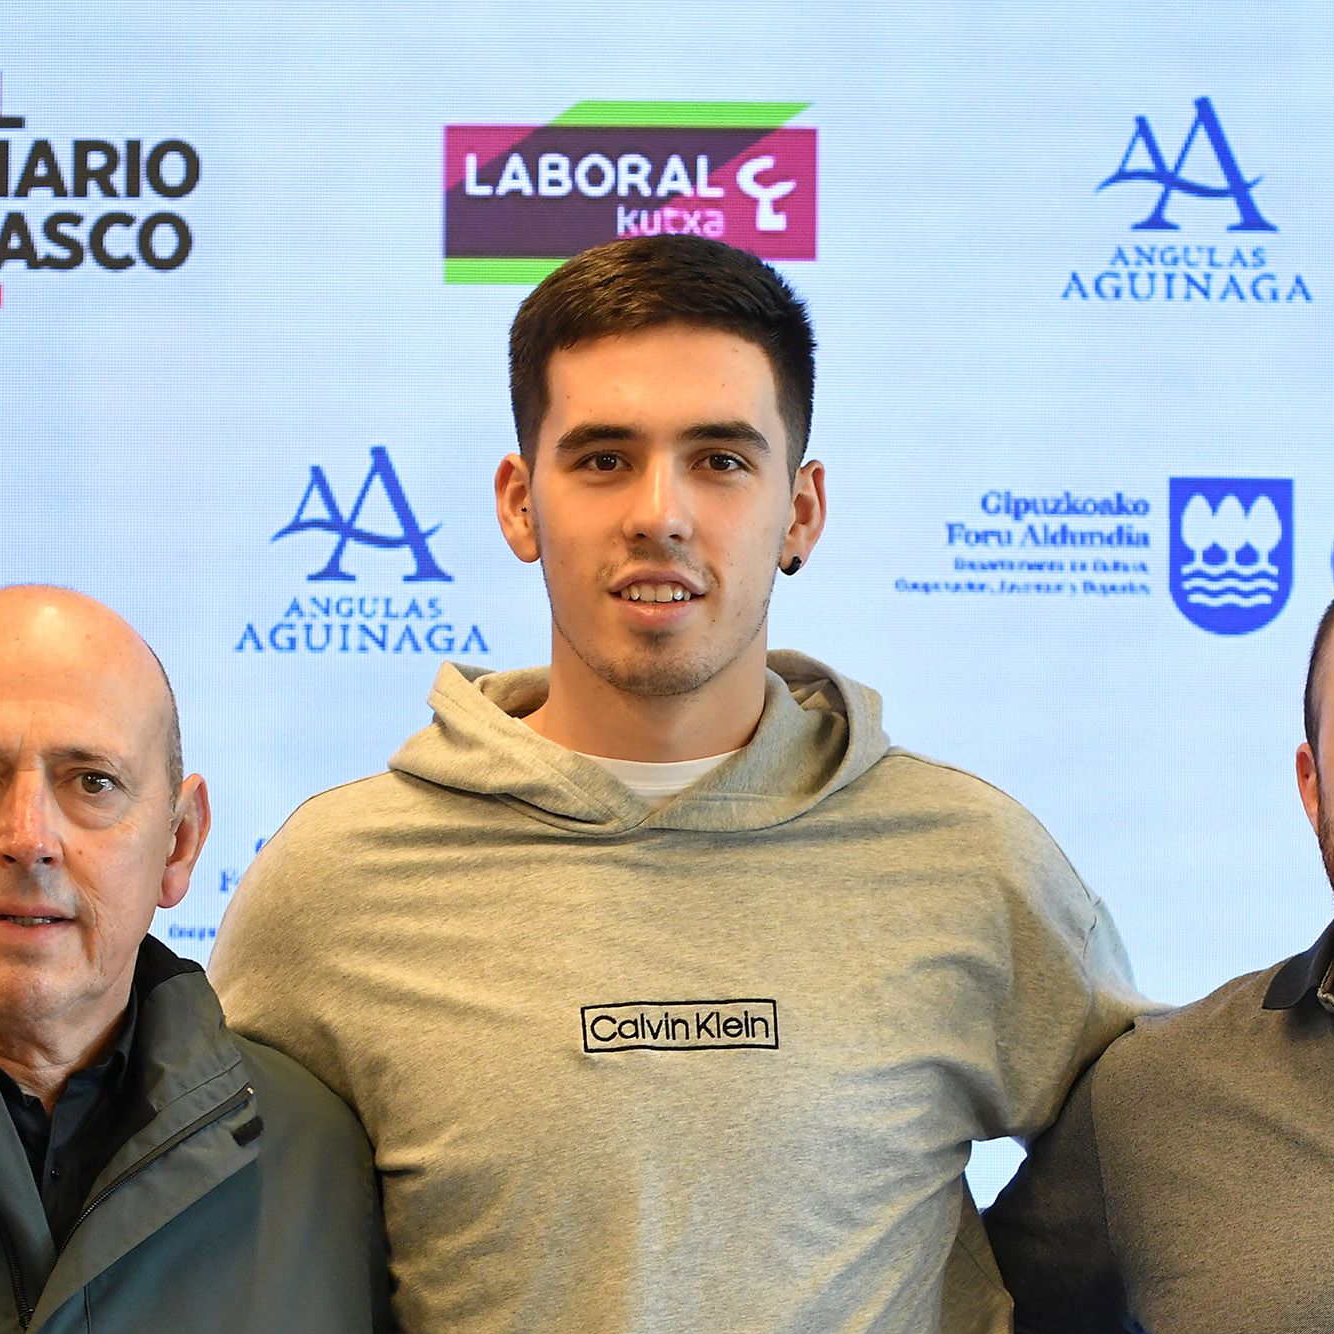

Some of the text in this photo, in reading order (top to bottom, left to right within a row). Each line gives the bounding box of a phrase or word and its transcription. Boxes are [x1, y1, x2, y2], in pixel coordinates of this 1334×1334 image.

[466, 154, 724, 197] LABORAL
[617, 206, 723, 236] kutxa
[1110, 245, 1266, 269] ANGULAS
[1062, 272, 1312, 302] AGUINAGA
[946, 523, 1150, 547] Foru Aldundia
[284, 597, 442, 620] ANGULAS
[235, 624, 489, 654] AGUINAGA
[590, 1010, 769, 1042] Calvin Klein
